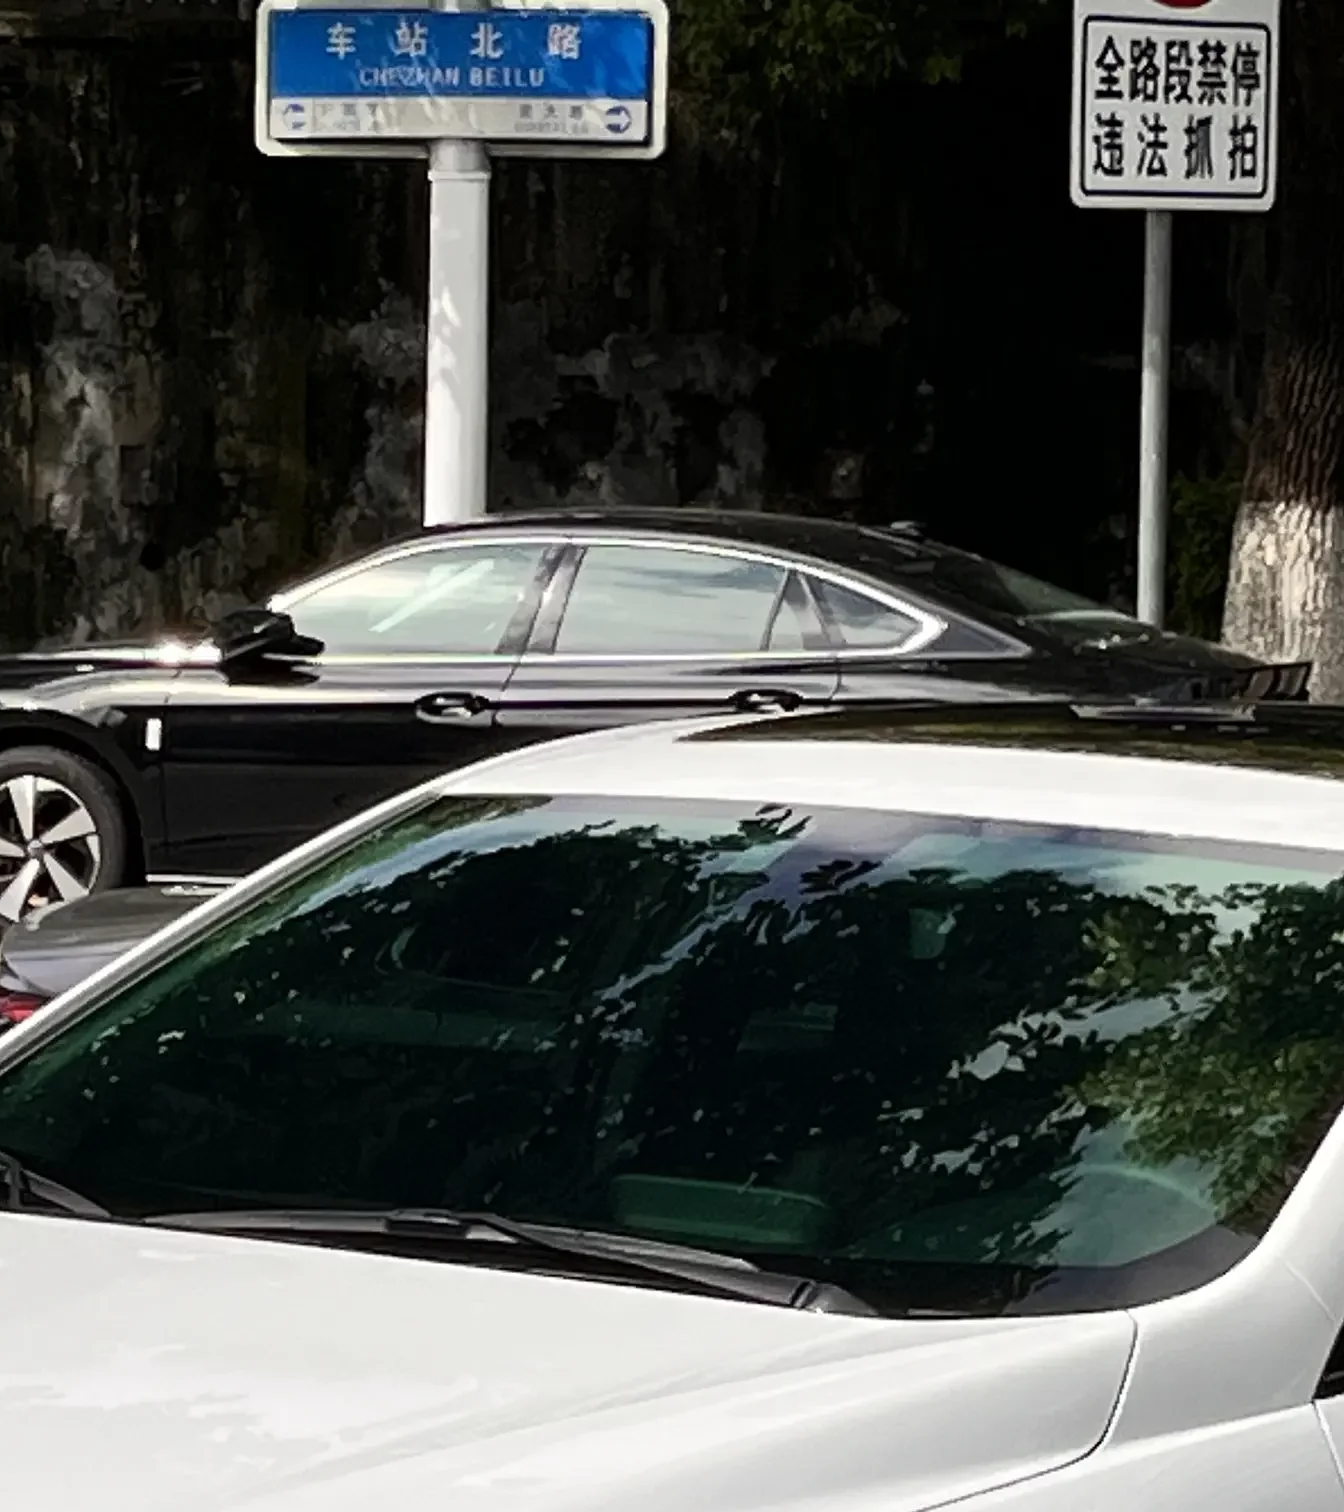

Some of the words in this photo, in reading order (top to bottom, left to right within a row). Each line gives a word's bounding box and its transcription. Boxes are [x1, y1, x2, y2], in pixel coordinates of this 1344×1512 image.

[326, 22, 581, 60] 车站北路
[1094, 35, 1261, 107] 全路段禁停
[1092, 112, 1258, 180] 违法抓拍
